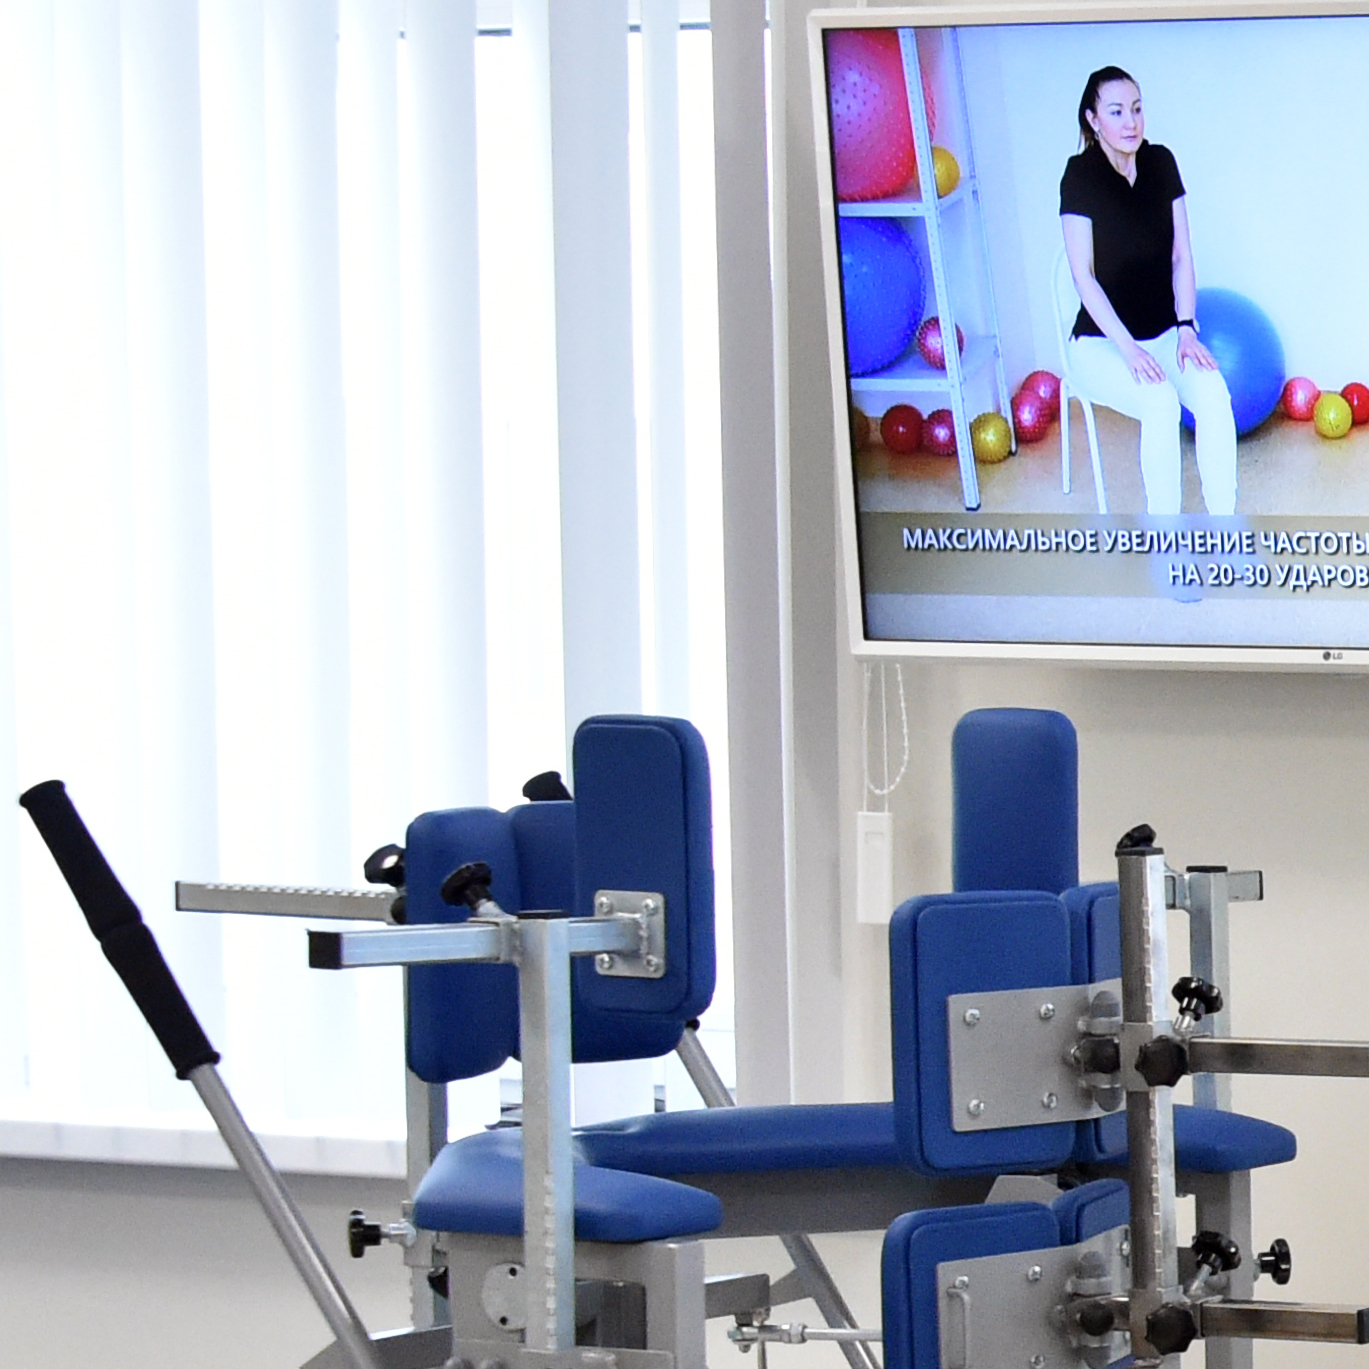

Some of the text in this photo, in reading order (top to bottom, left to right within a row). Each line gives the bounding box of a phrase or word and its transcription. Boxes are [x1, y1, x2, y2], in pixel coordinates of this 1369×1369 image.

[902, 527, 1097, 552] МАКСИМАЛЬНОЕ
[1103, 529, 1255, 553] УВЕЛИЧЕНИЕ
[1168, 563, 1201, 586] НА
[1207, 563, 1270, 587] 20-30
[1276, 564, 1369, 592] УДАРОВ
